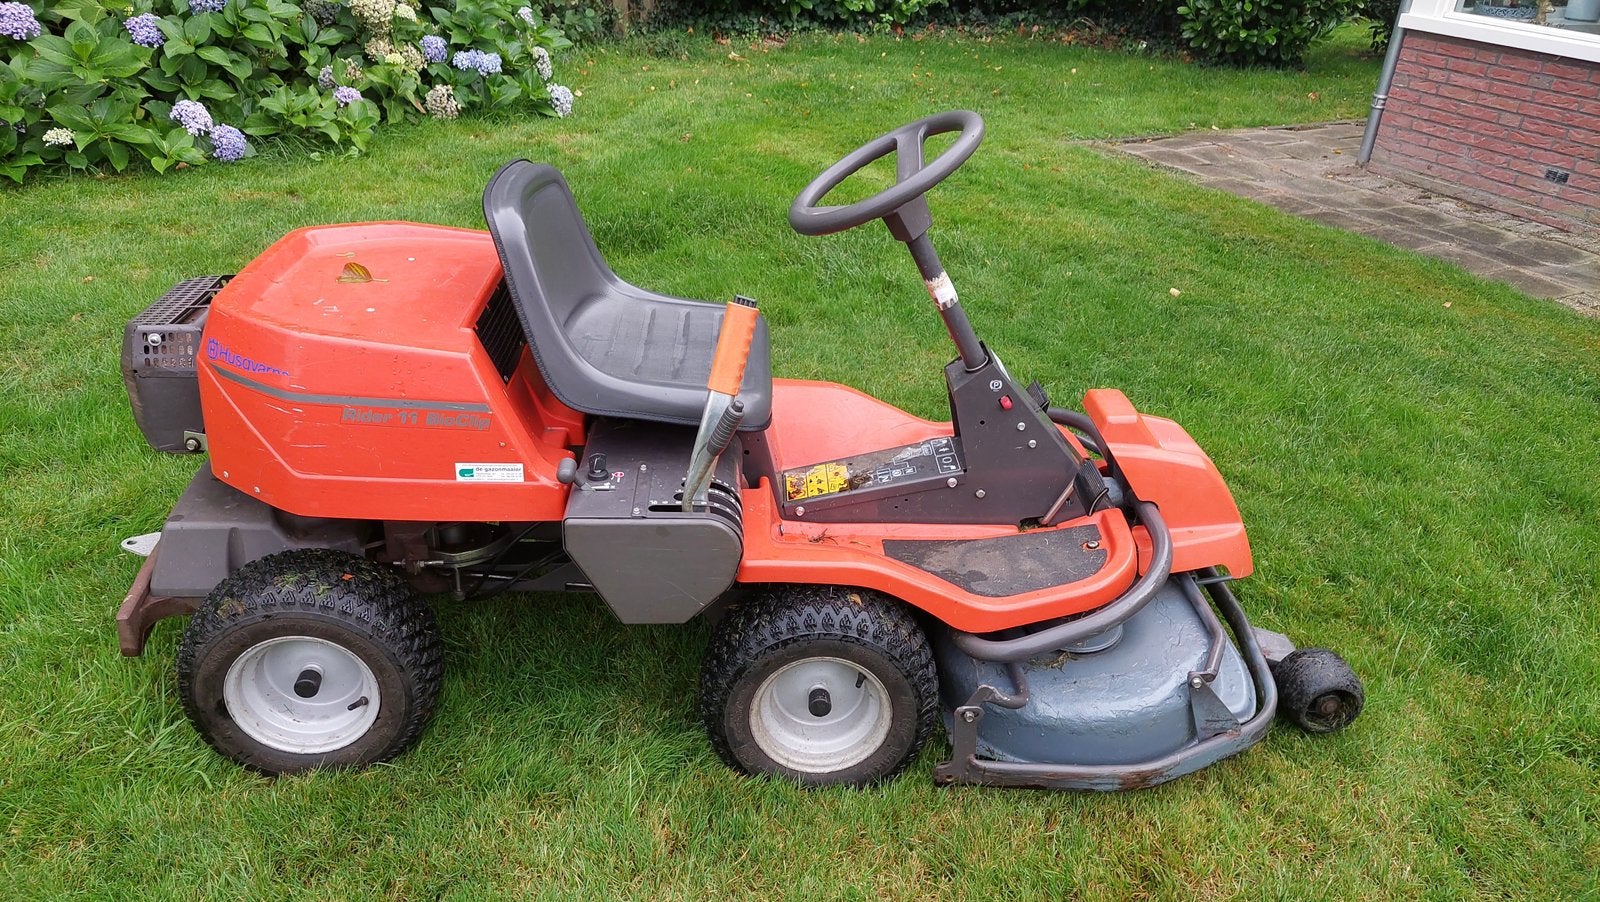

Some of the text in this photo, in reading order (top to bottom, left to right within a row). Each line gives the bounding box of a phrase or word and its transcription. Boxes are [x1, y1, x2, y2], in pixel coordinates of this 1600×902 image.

[342, 409, 490, 430] Rider 11 BioClip
